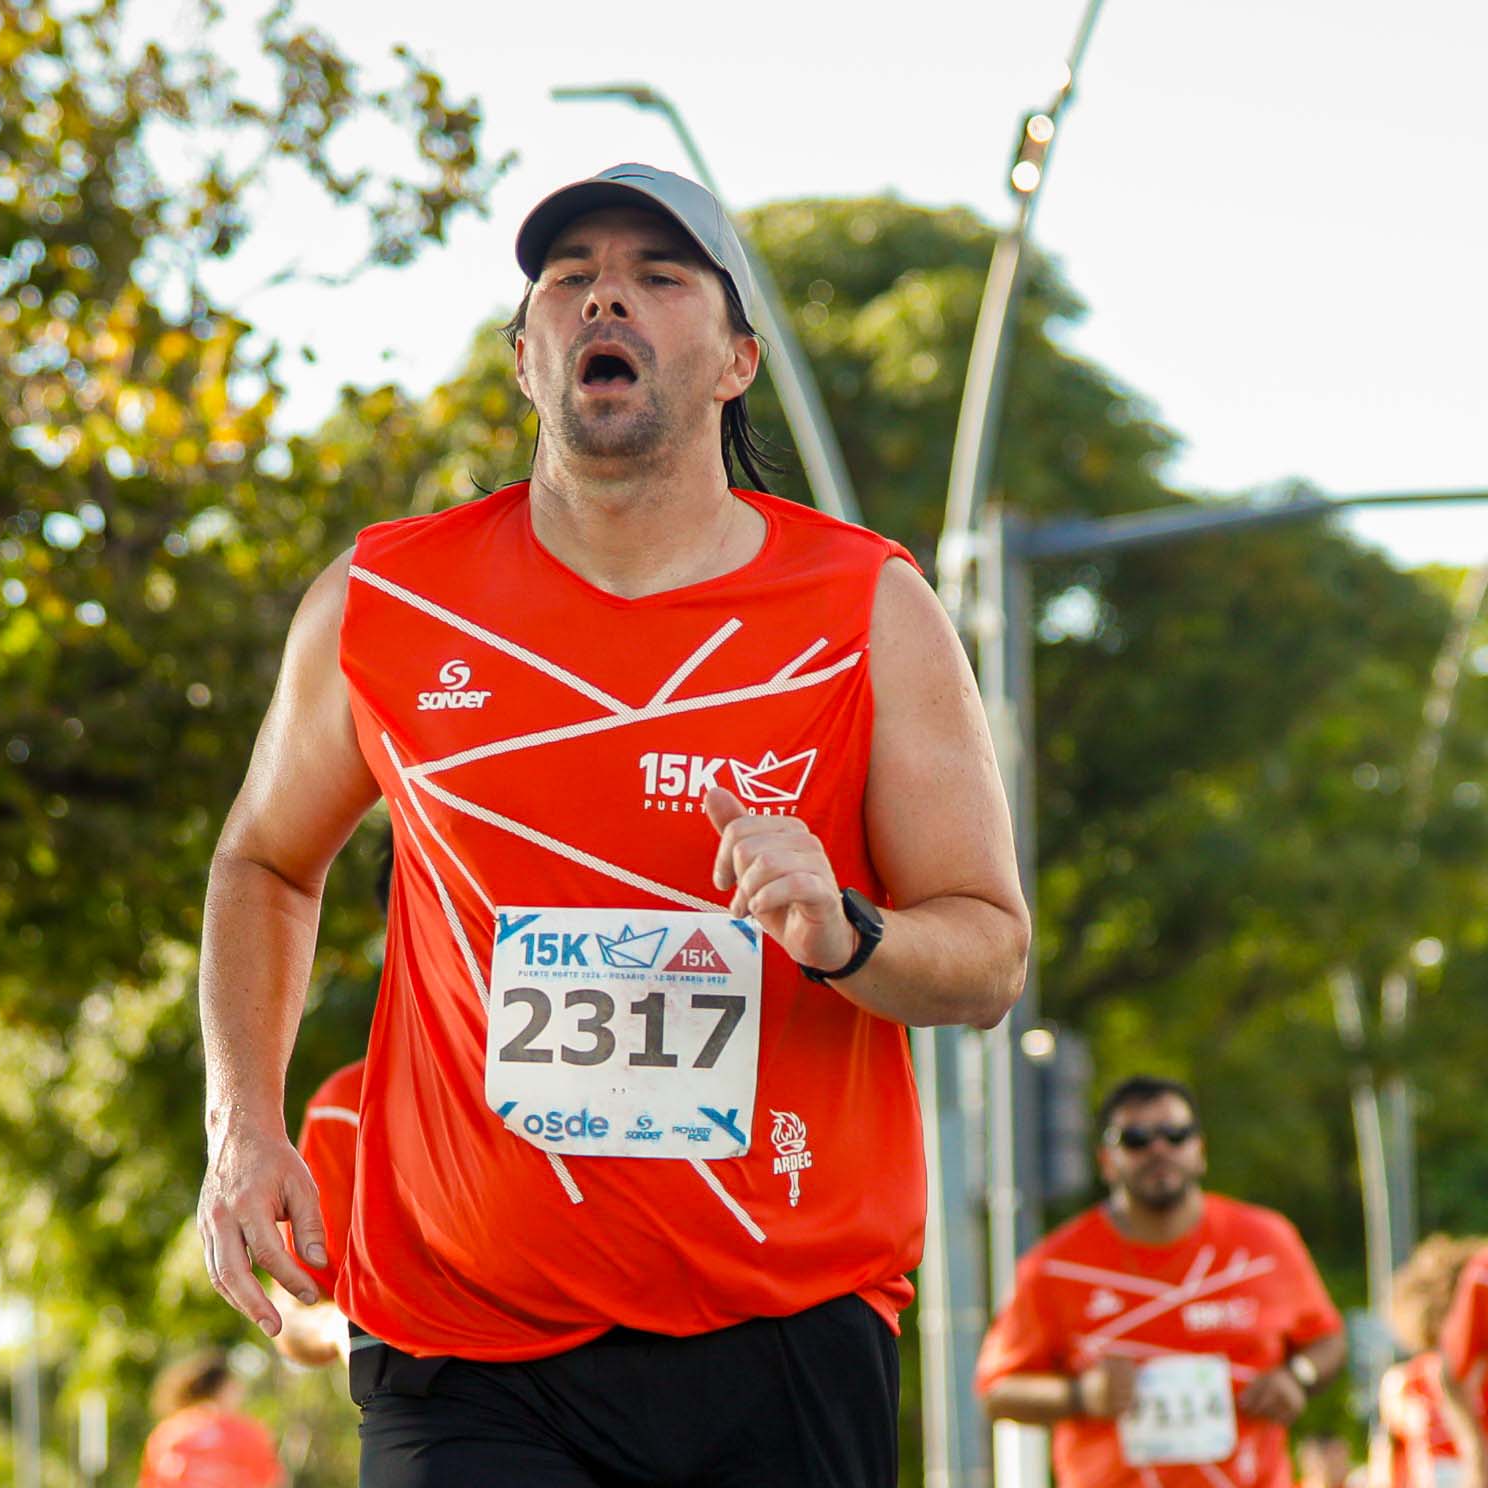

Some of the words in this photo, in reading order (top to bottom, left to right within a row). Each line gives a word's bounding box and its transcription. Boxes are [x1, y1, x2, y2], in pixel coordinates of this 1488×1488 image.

[639, 752, 727, 798] 15K
[644, 800, 707, 814] PUERT
[748, 805, 798, 817] ORTE
[520, 932, 589, 967] 15K
[679, 948, 716, 968] 15K
[498, 987, 746, 1068] 2317
[523, 1107, 609, 1139] osde
[773, 1150, 812, 1175] ARDEC
